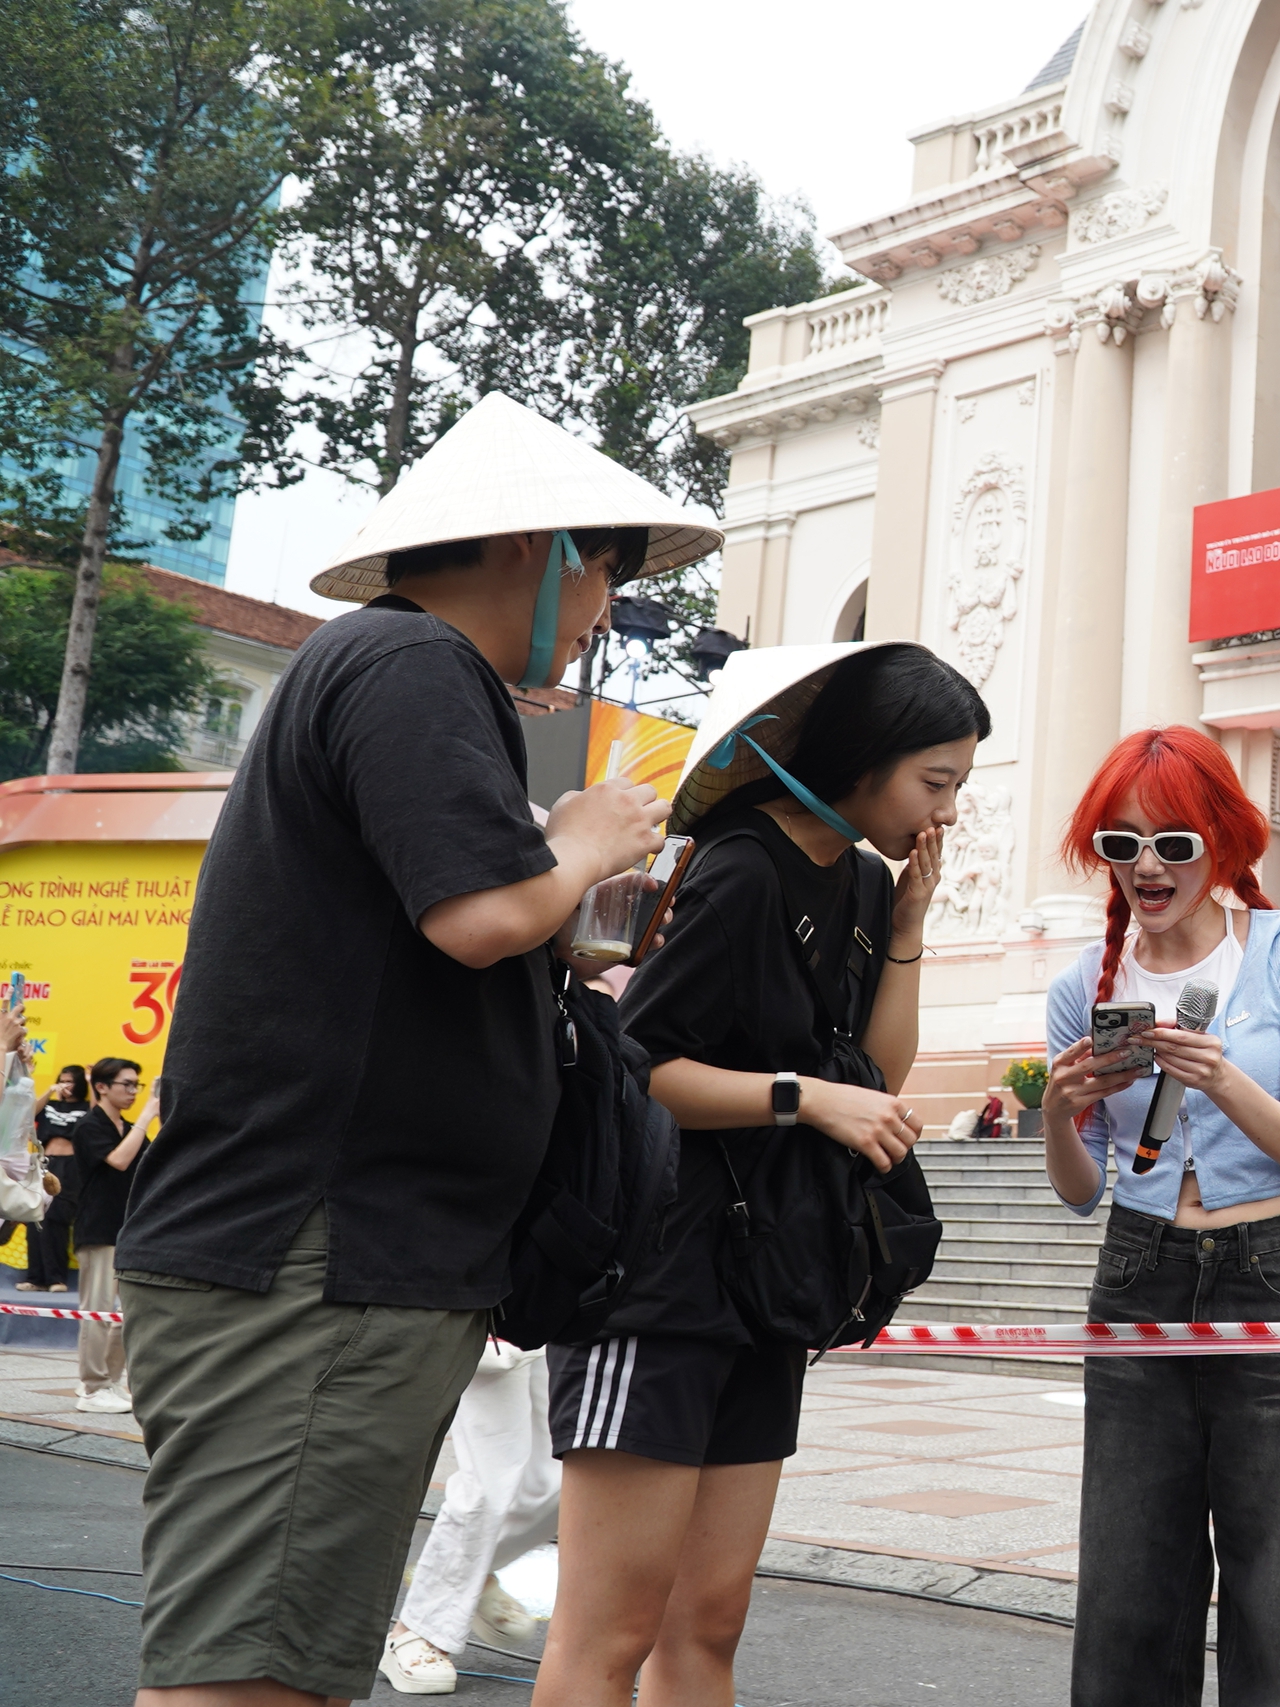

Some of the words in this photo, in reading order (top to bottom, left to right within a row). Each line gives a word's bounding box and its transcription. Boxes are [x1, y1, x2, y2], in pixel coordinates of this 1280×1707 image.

[40, 875, 83, 899] TRÌNH
[88, 877, 130, 902] NGHỆ
[136, 876, 191, 902] THUẬT
[0, 903, 14, 926] Ễ
[17, 909, 66, 927] TRAO
[71, 904, 104, 927] GIẢI
[108, 909, 139, 926] MAI
